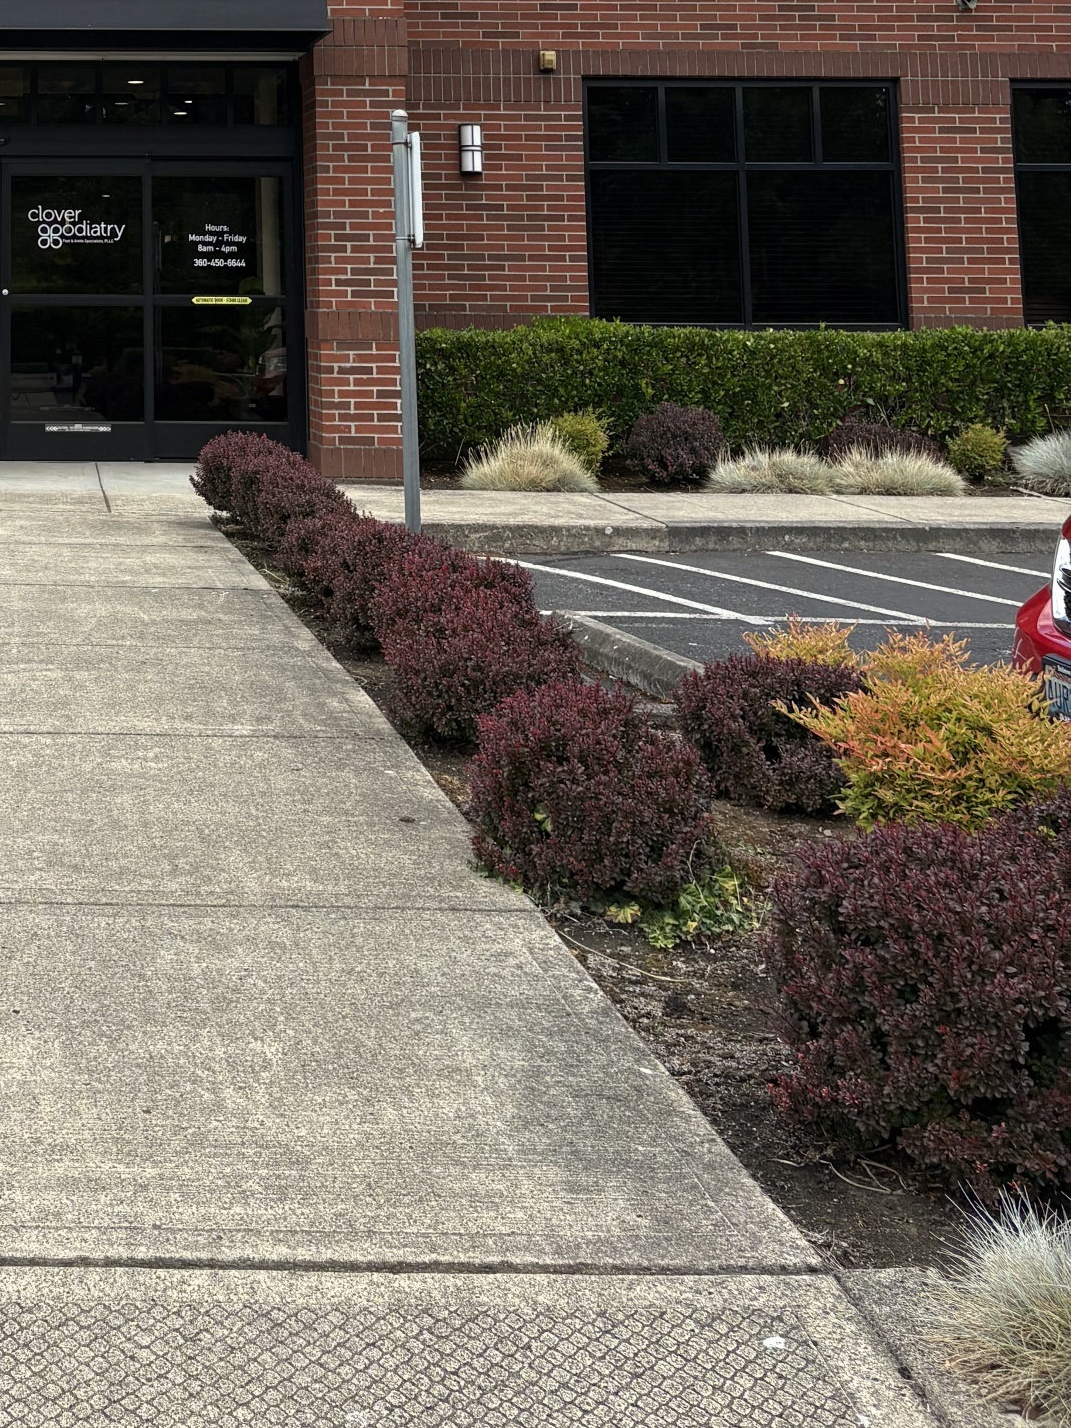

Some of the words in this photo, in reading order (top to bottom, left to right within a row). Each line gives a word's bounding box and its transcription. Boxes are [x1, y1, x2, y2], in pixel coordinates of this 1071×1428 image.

[28, 205, 82, 222] clover
[50, 220, 126, 243] podiatry
[205, 223, 230, 232] Hours:
[188, 233, 217, 243] Monday
[223, 233, 247, 243] Friday
[197, 243, 214, 252] 8am
[220, 244, 238, 254] 4pm
[193, 258, 246, 267] 360-450-6644
